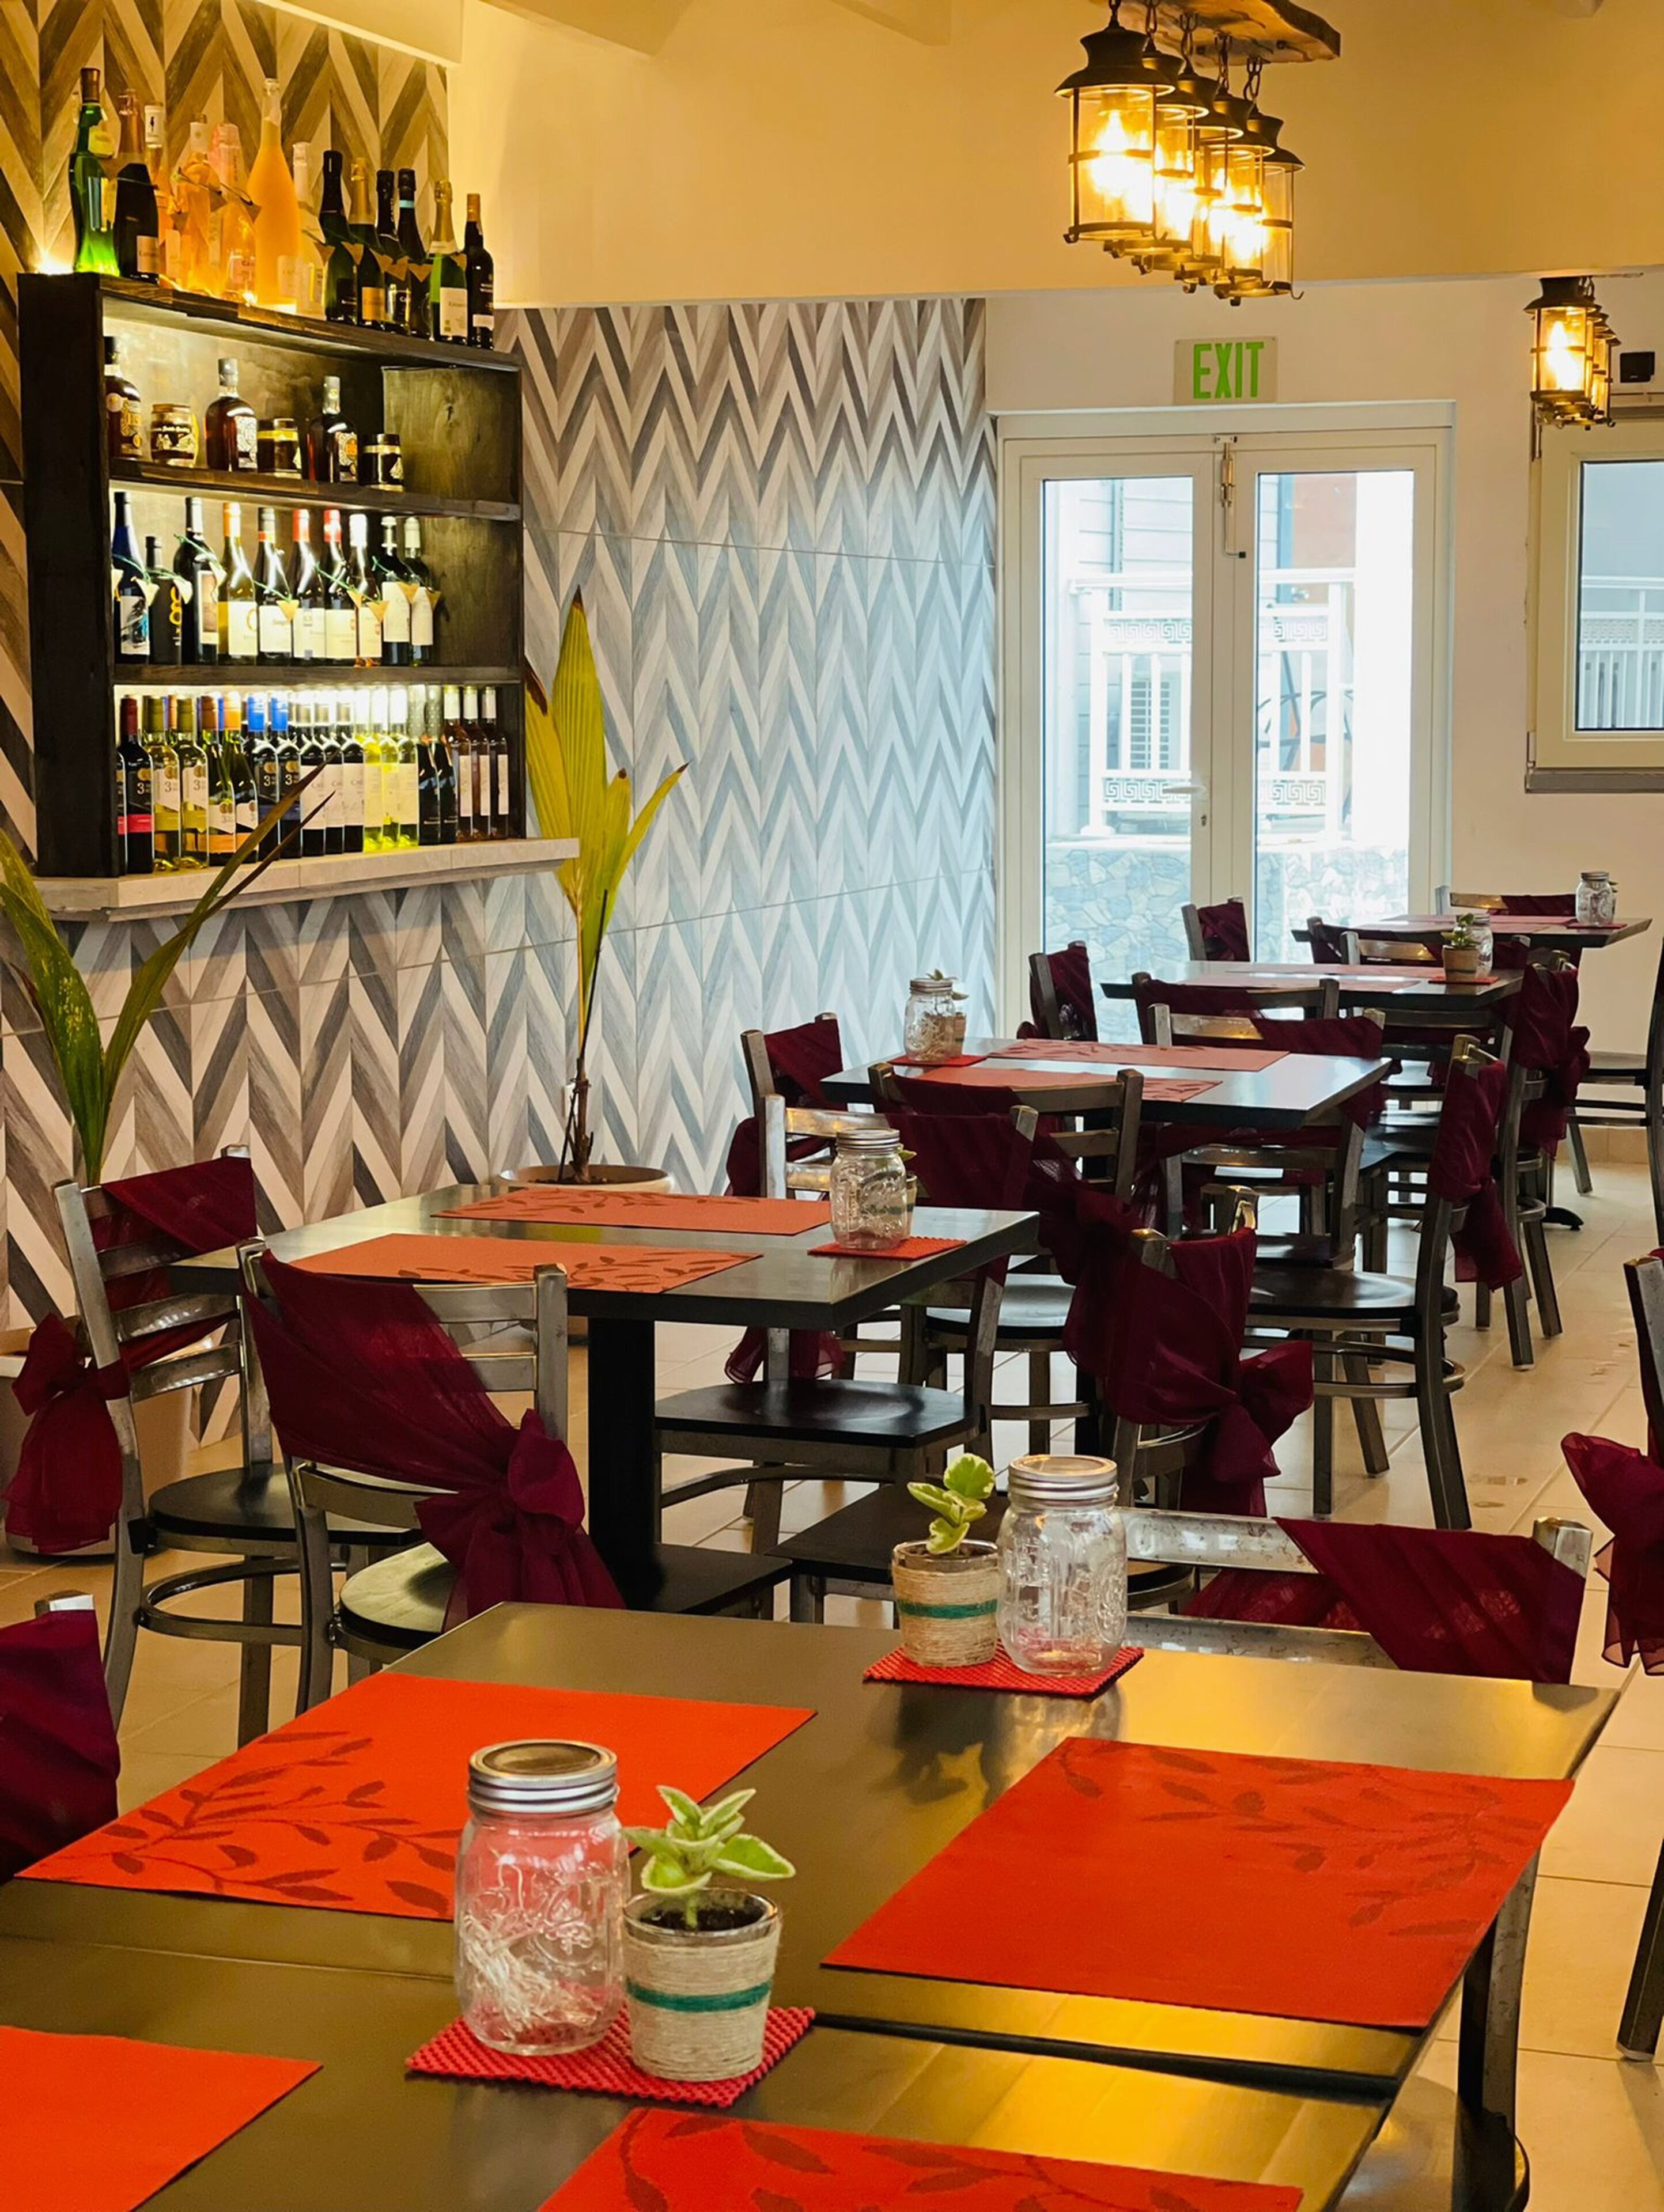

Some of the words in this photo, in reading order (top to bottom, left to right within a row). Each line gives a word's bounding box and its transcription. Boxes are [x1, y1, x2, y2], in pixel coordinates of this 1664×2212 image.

[1193, 342, 1264, 399] EXIT
[263, 775, 271, 787] 3
[285, 774, 292, 786] 3
[137, 782, 144, 794] 3
[165, 781, 172, 793] 3
